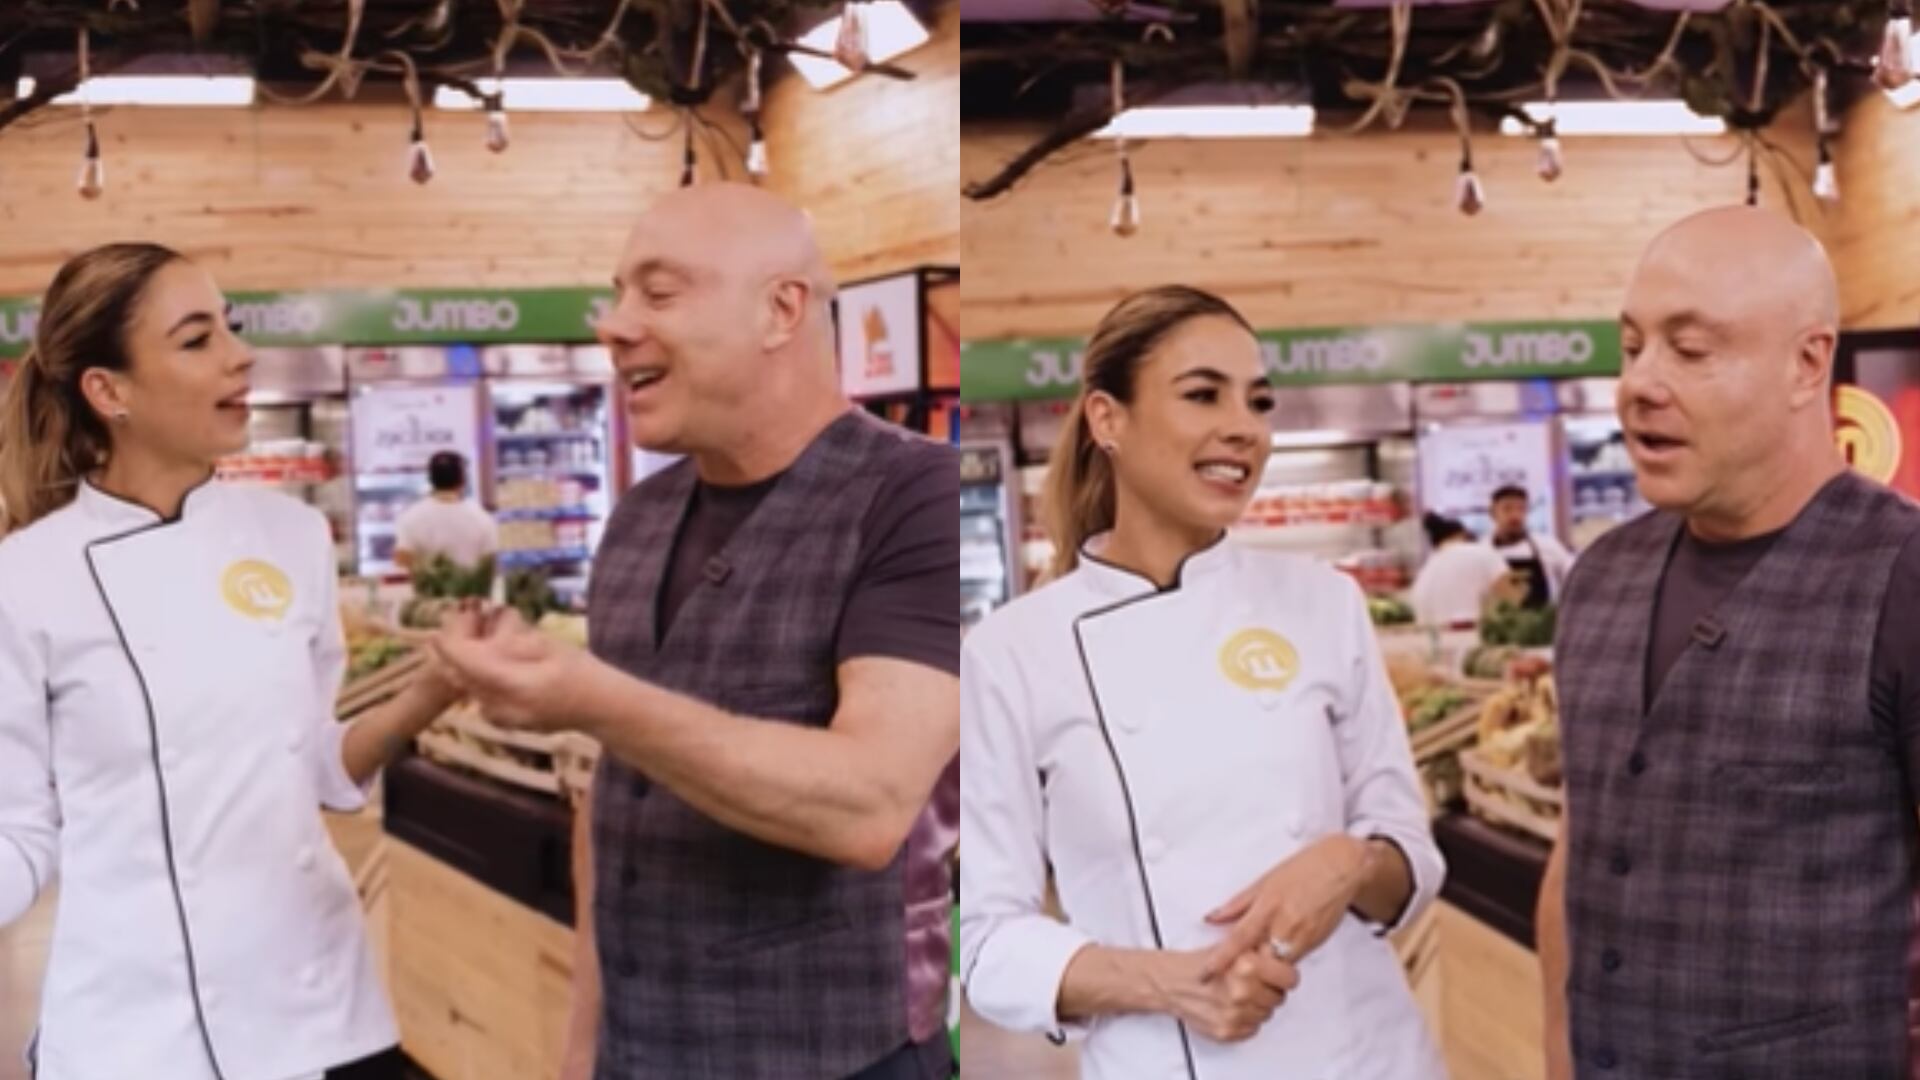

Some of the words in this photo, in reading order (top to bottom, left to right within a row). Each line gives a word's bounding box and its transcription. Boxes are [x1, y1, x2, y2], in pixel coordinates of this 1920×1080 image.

[392, 298, 518, 330] JUMBO
[1462, 331, 1593, 367] JUMBO
[1025, 351, 1085, 387] JU
